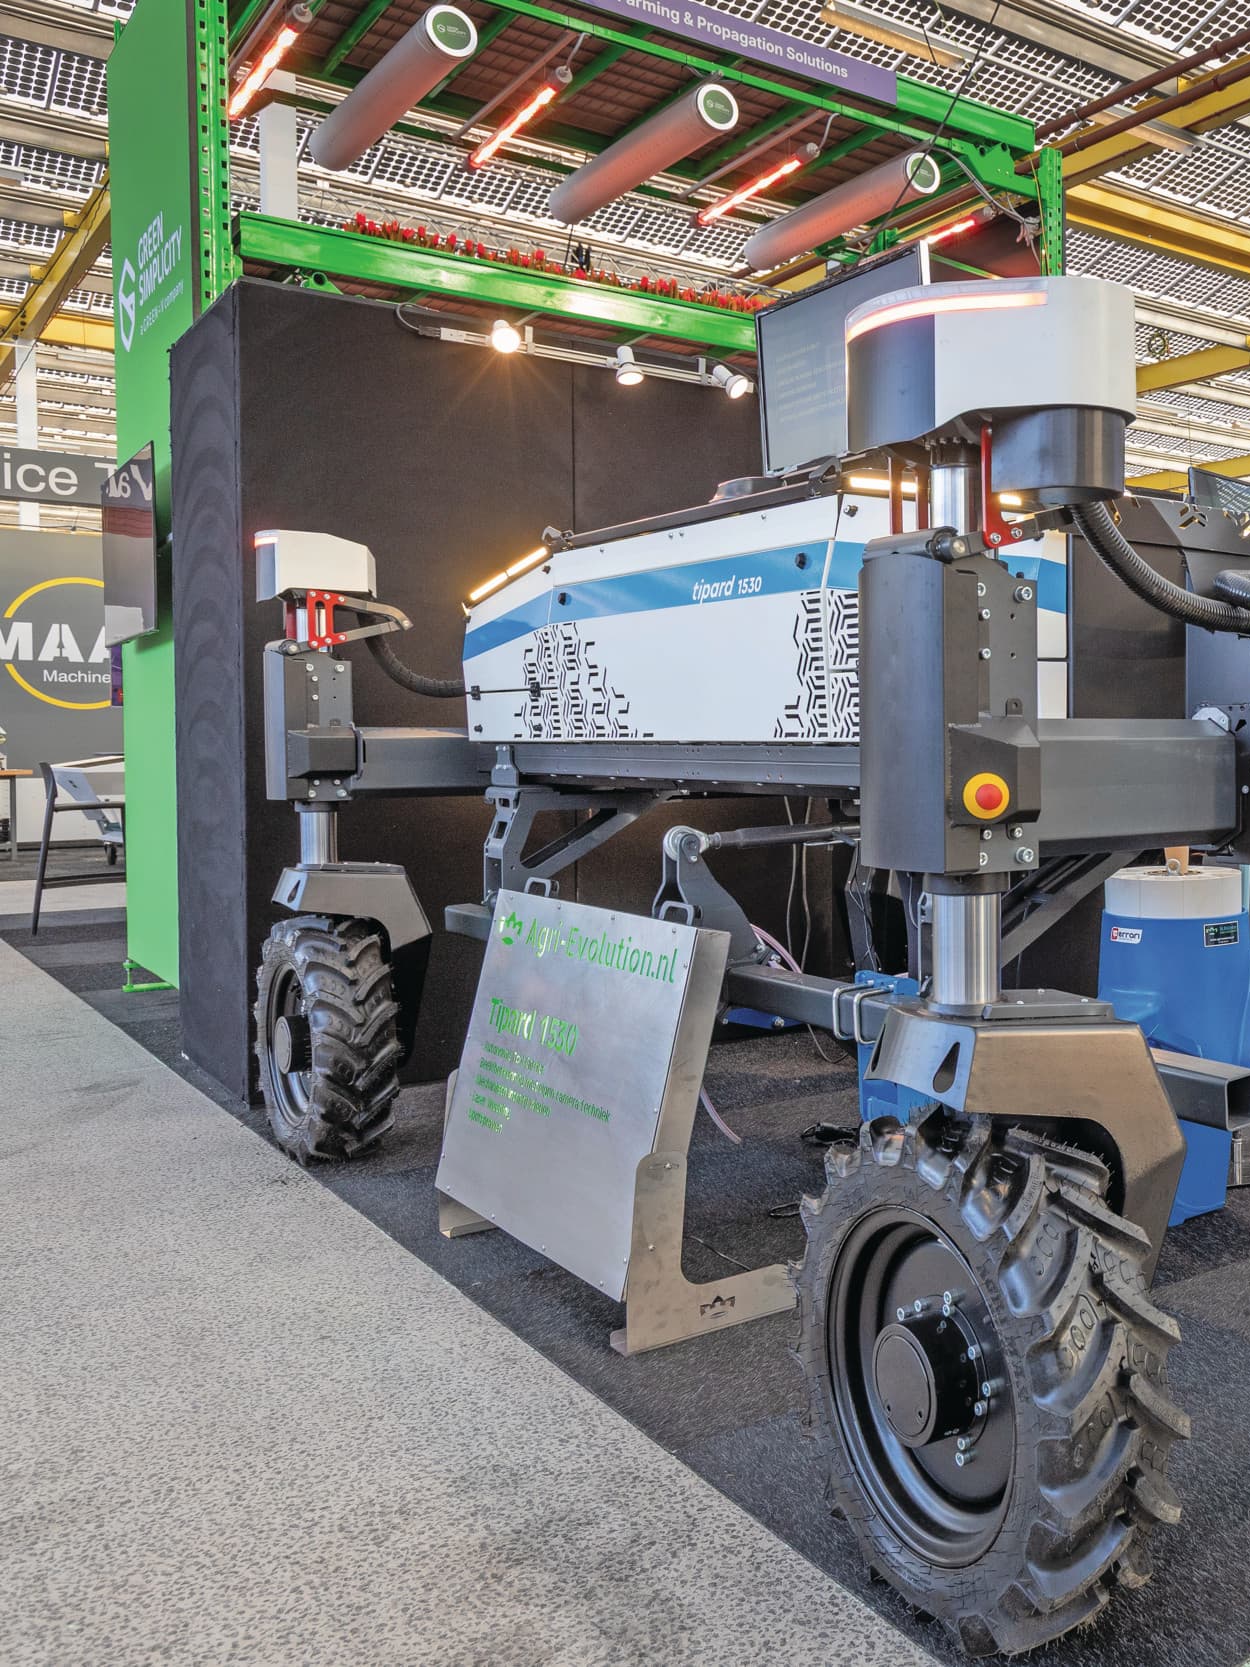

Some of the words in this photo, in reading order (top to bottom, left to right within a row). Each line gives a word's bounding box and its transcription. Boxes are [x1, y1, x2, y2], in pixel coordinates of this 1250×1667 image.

[618, 0, 680, 24] arming
[683, 11, 694, 27] &
[697, 16, 783, 58] Propagation
[786, 47, 848, 78] Solutions
[138, 211, 163, 270] GREEN
[139, 224, 182, 307] SIMPLICITY
[692, 574, 736, 606] tipard
[738, 576, 762, 595] 1530
[525, 917, 678, 984] Agri-Evolution.nl
[489, 997, 537, 1041] Tipard
[539, 1015, 580, 1057] 1530
